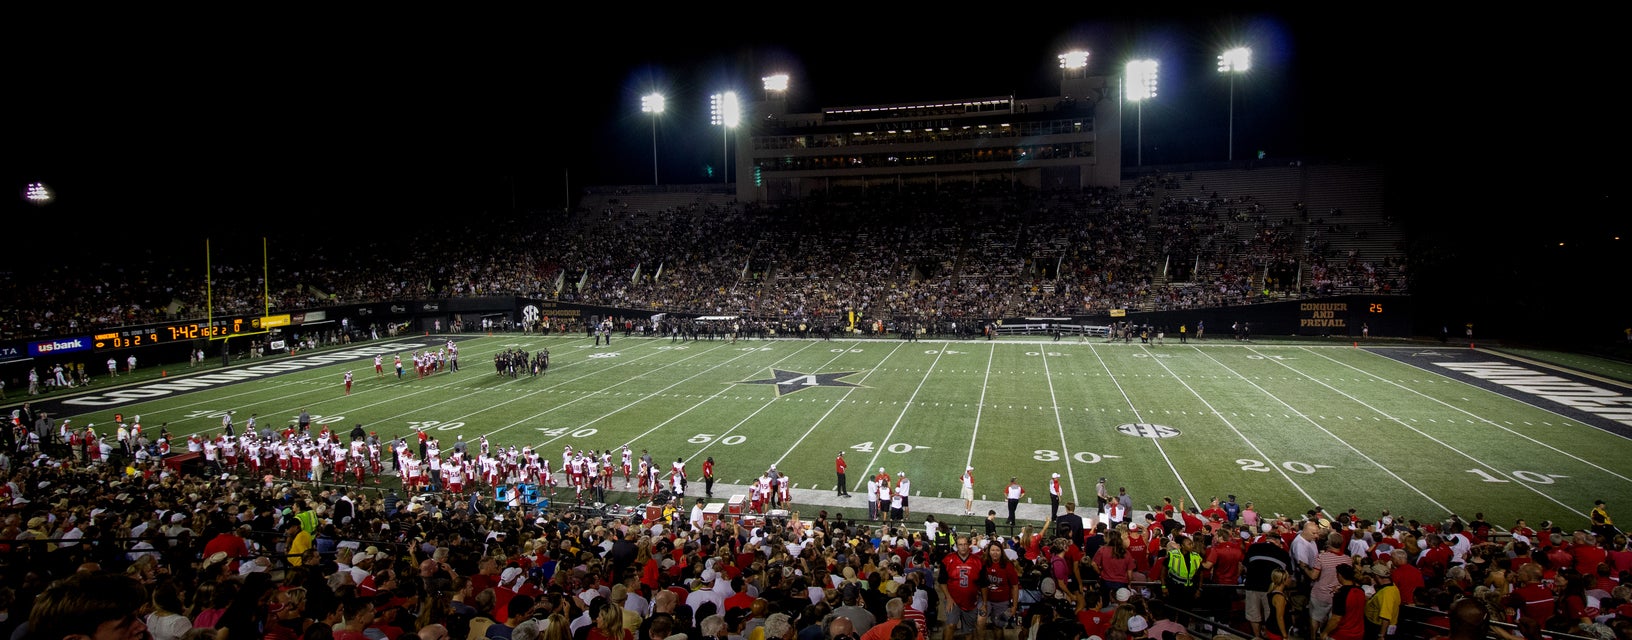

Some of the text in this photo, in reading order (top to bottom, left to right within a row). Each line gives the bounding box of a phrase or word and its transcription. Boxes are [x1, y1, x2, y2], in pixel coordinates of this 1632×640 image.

[1300, 303, 1348, 311] CONQUER
[1369, 303, 1383, 313] 25
[523, 305, 540, 322] SEC
[1312, 310, 1335, 319] AND
[234, 323, 240, 333] 0
[1300, 319, 1346, 327] PREVAIL
[167, 324, 198, 340] 7:42
[212, 326, 218, 336] 2
[113, 337, 121, 348] 0
[124, 338, 130, 347] 3
[134, 335, 141, 346] 2
[150, 333, 157, 343] 9
[687, 432, 747, 446] 50
[850, 441, 914, 454] 40
[1033, 449, 1102, 464] 30
[1236, 459, 1317, 475] 20
[1465, 468, 1556, 485] 10
[959, 568, 969, 588] 5
